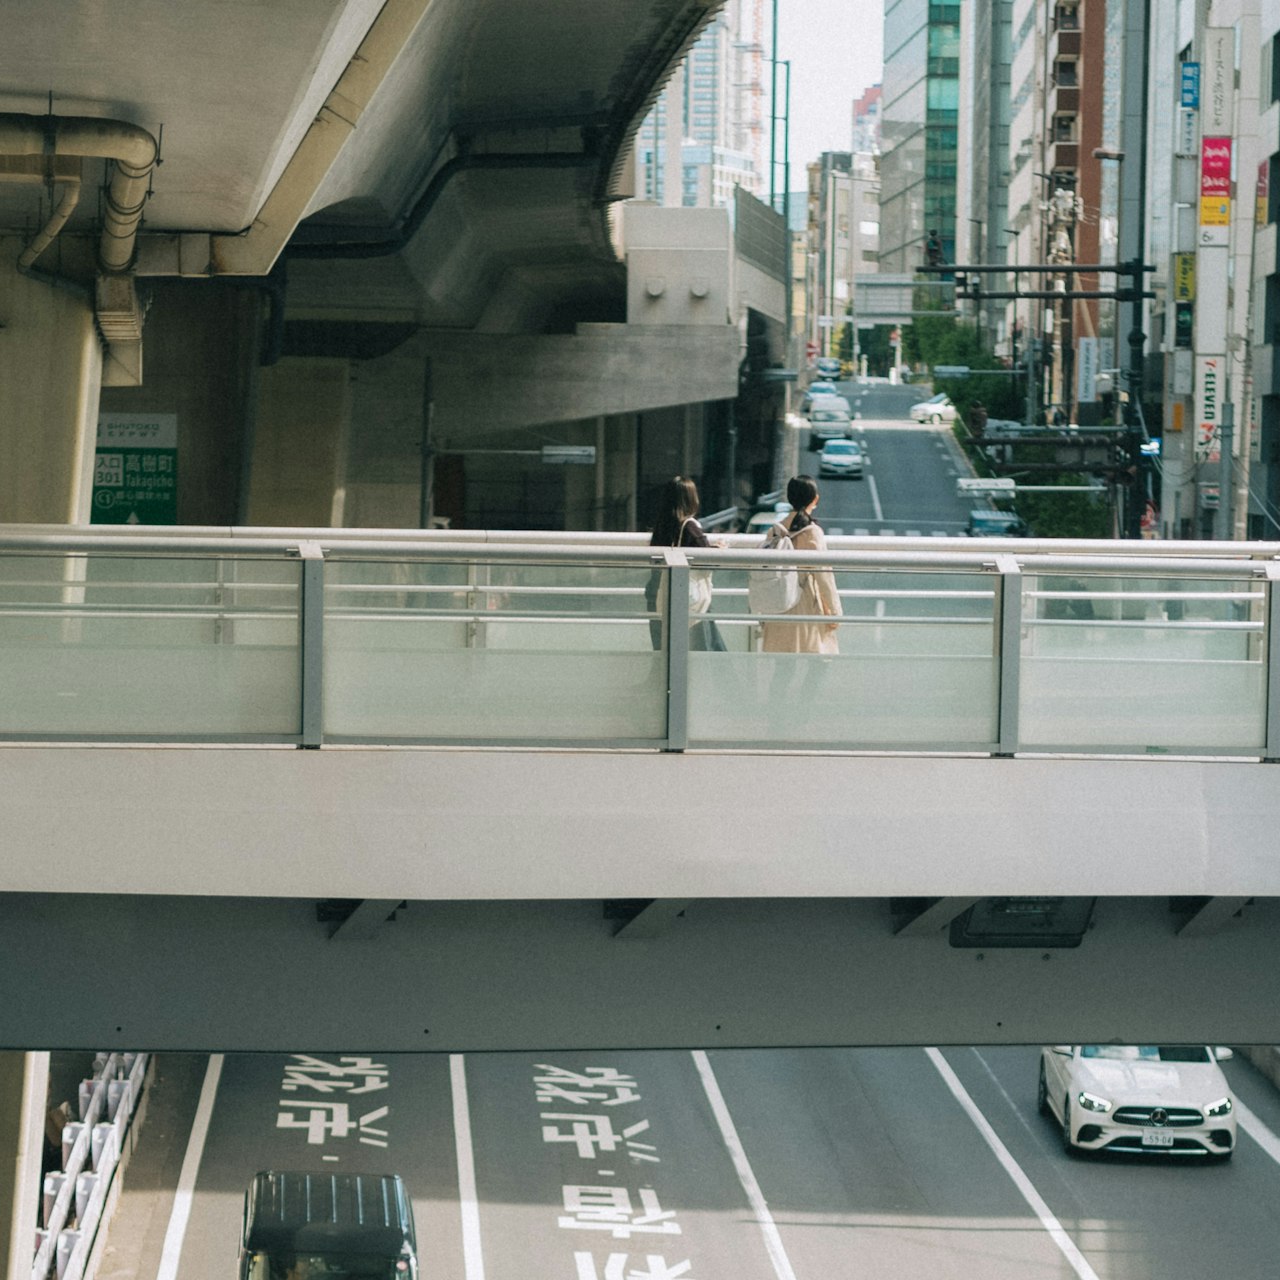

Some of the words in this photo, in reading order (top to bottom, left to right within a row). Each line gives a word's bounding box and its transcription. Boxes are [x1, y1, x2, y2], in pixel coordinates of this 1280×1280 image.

[97, 457, 120, 468] 入口
[125, 455, 173, 473] 高樹町
[95, 471, 121, 484] 301
[126, 475, 173, 489] Takagicho
